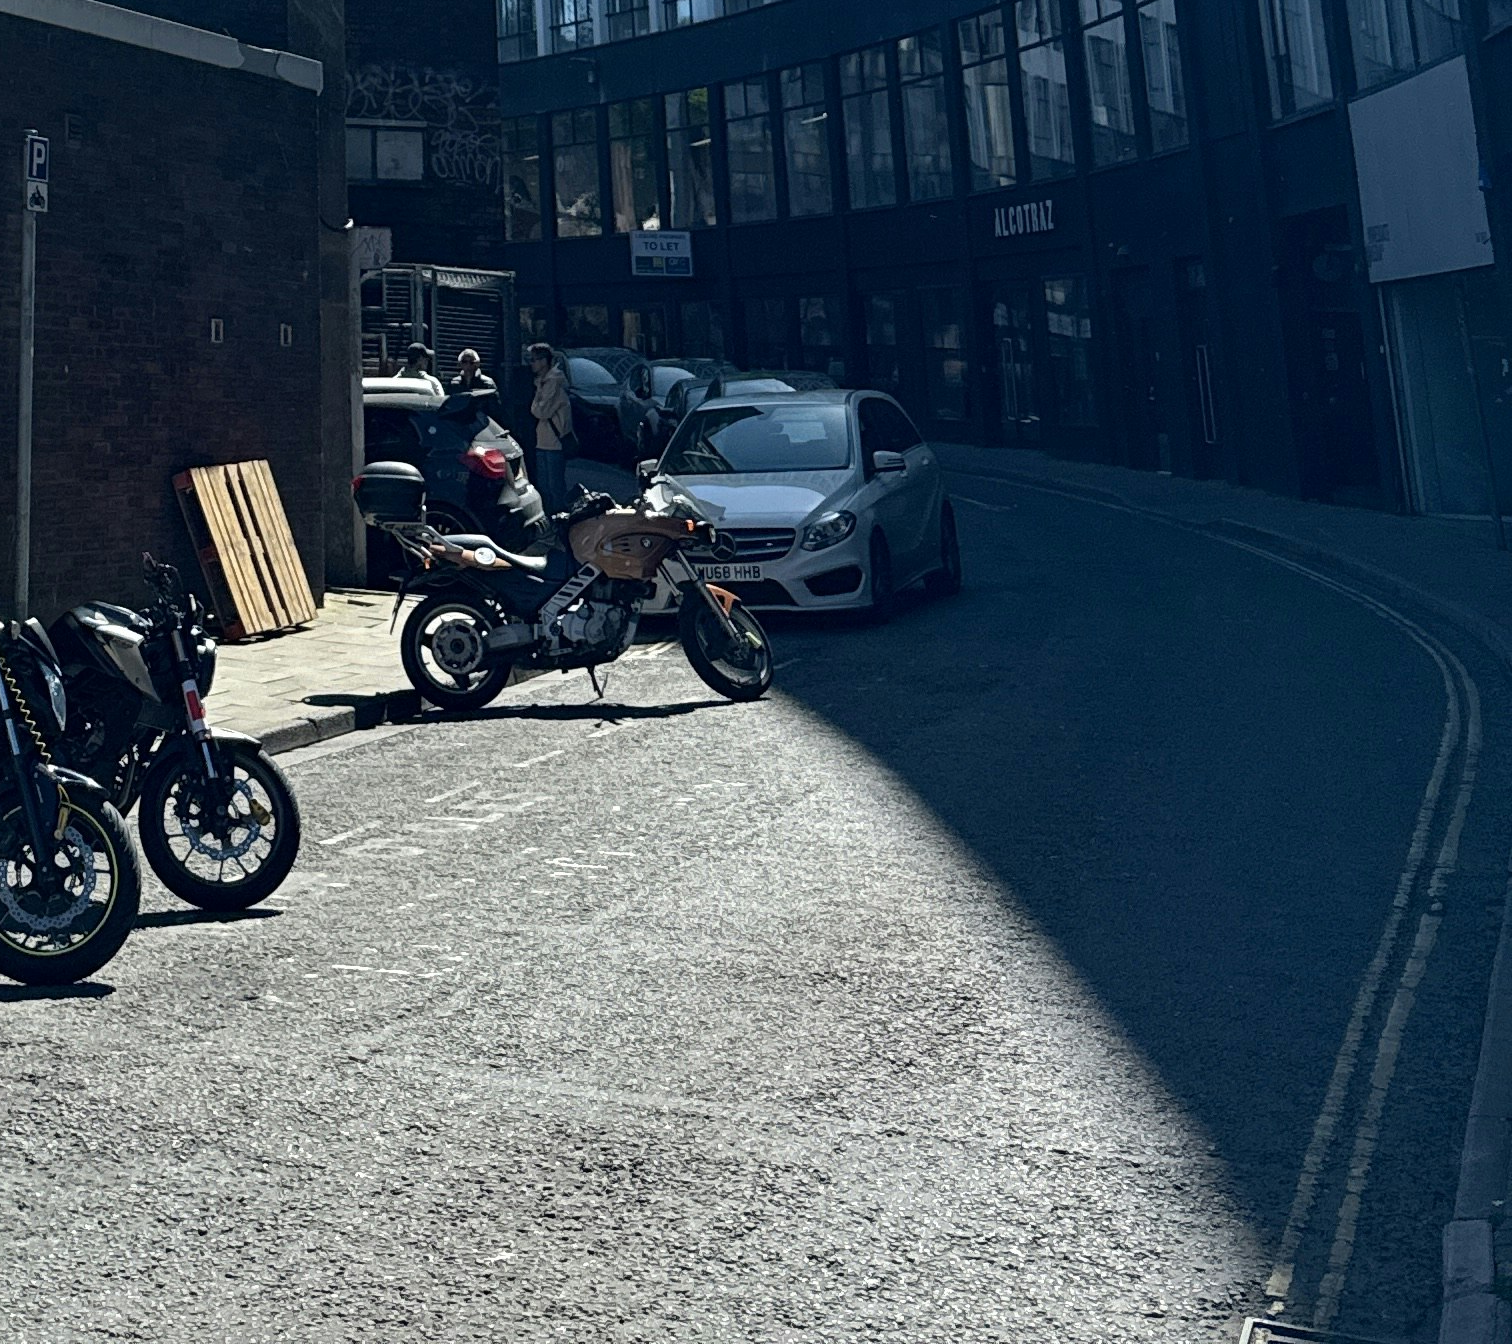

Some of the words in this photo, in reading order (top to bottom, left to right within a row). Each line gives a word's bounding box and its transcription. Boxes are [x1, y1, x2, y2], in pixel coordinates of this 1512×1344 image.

[31, 141, 46, 177] P
[994, 199, 1055, 238] ALCOTRAZ
[643, 241, 658, 251] TO
[660, 242, 680, 251] LET
[734, 565, 761, 580] HHB
